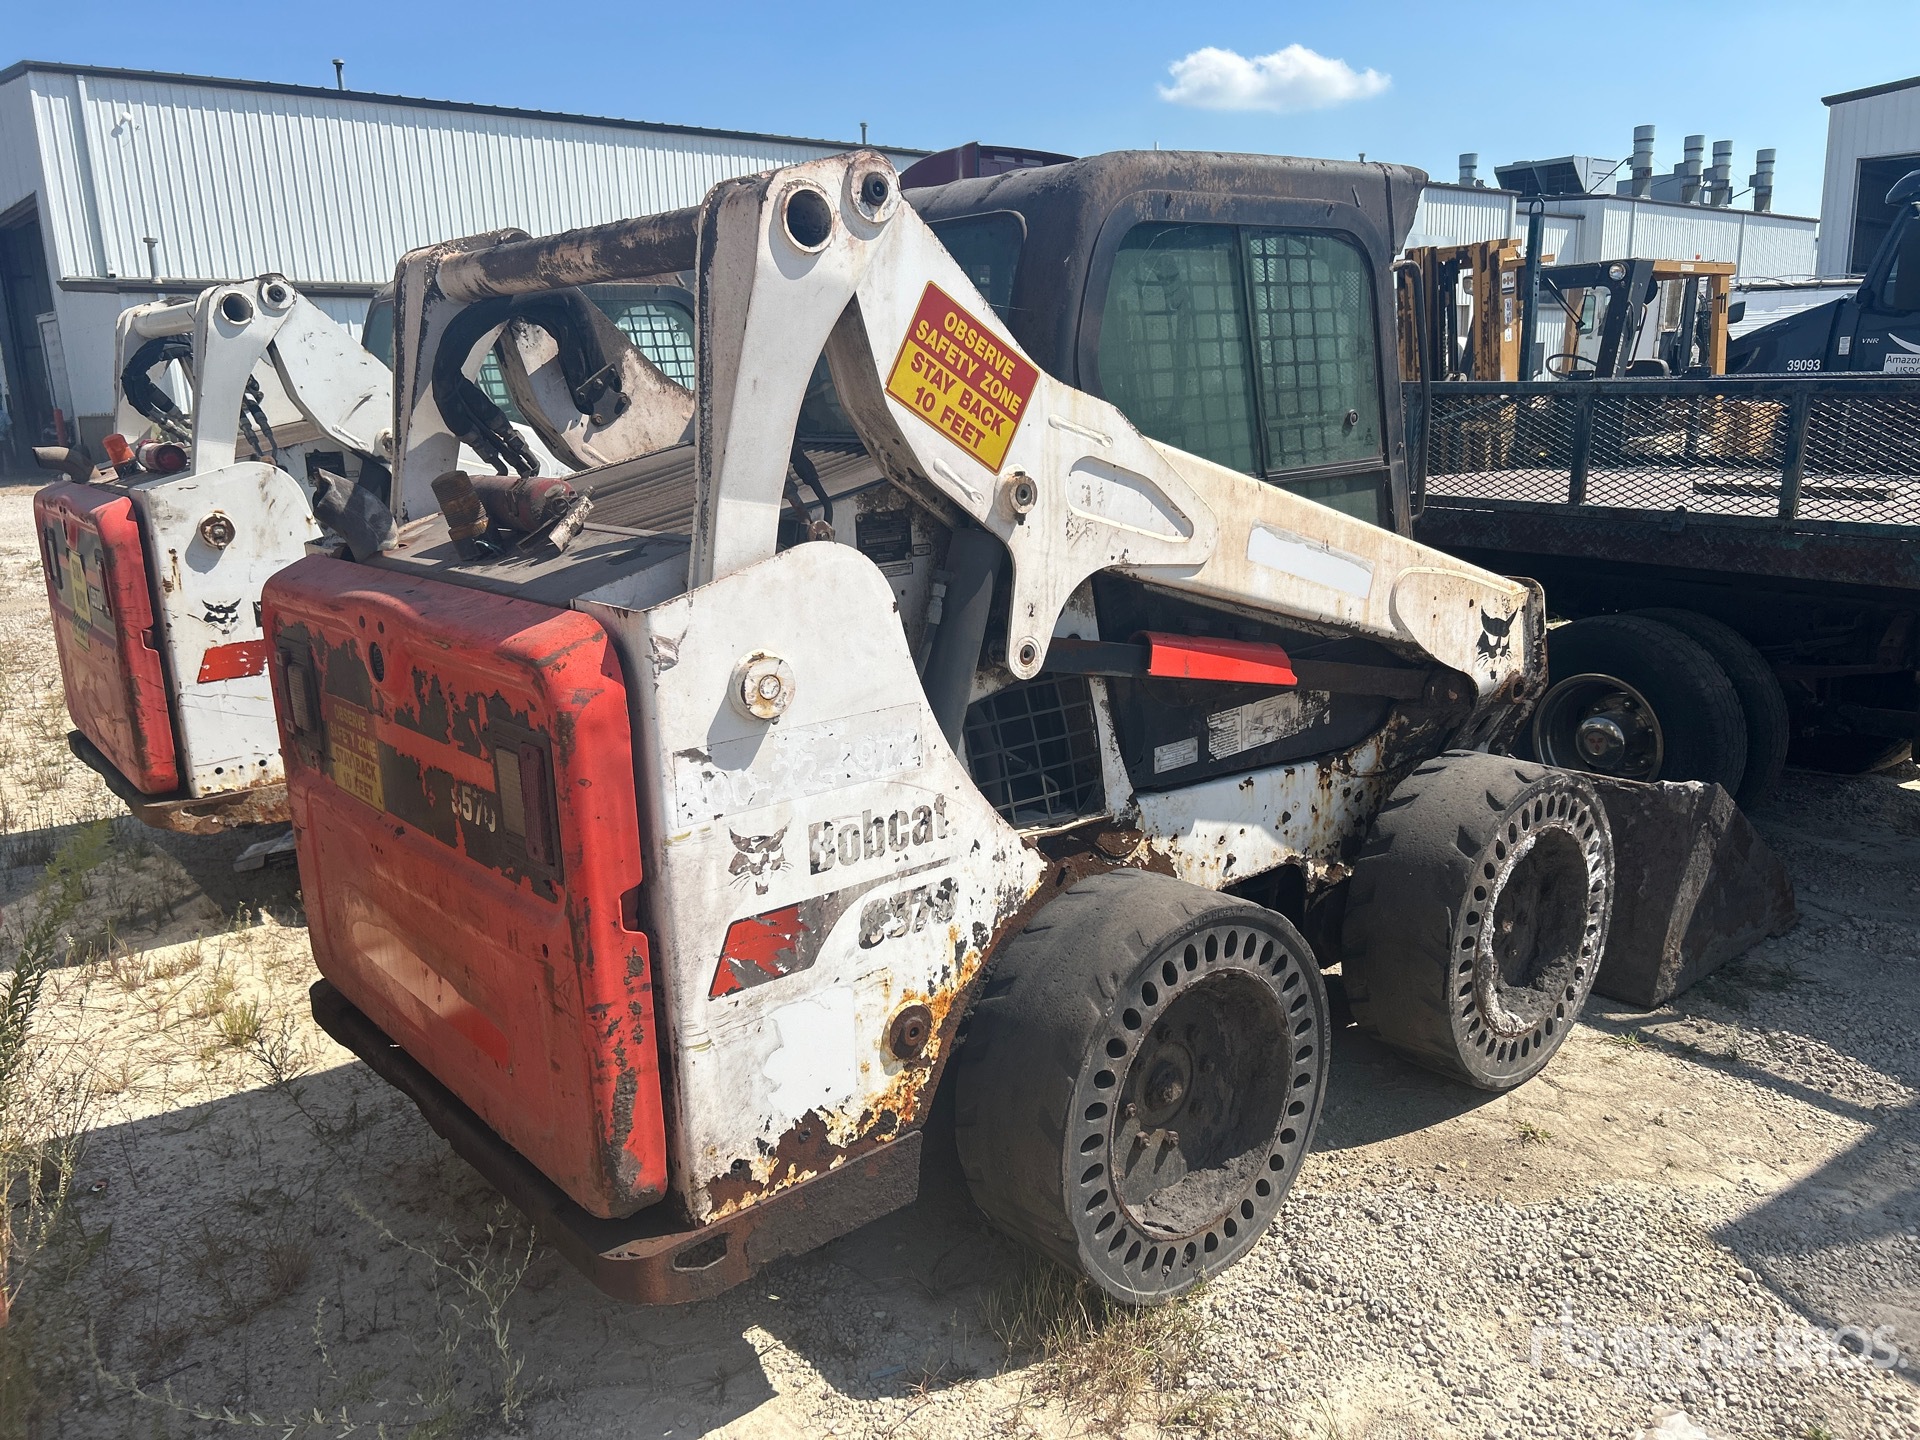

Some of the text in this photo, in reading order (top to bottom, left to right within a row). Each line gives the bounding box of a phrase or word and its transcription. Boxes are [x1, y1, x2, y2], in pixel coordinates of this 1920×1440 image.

[915, 319, 1022, 415] SAFETY ZONE
[944, 311, 1015, 380] OBSERVE
[1787, 359, 1820, 371] 39093
[911, 351, 1006, 437] STAY BACK
[915, 386, 986, 449] 10 FEET
[329, 720, 378, 759] SAFETY ZONE
[334, 703, 367, 732] OBSERVE
[355, 776, 374, 801] FEET
[356, 757, 377, 783] BACK
[808, 793, 948, 875] Bobcat
